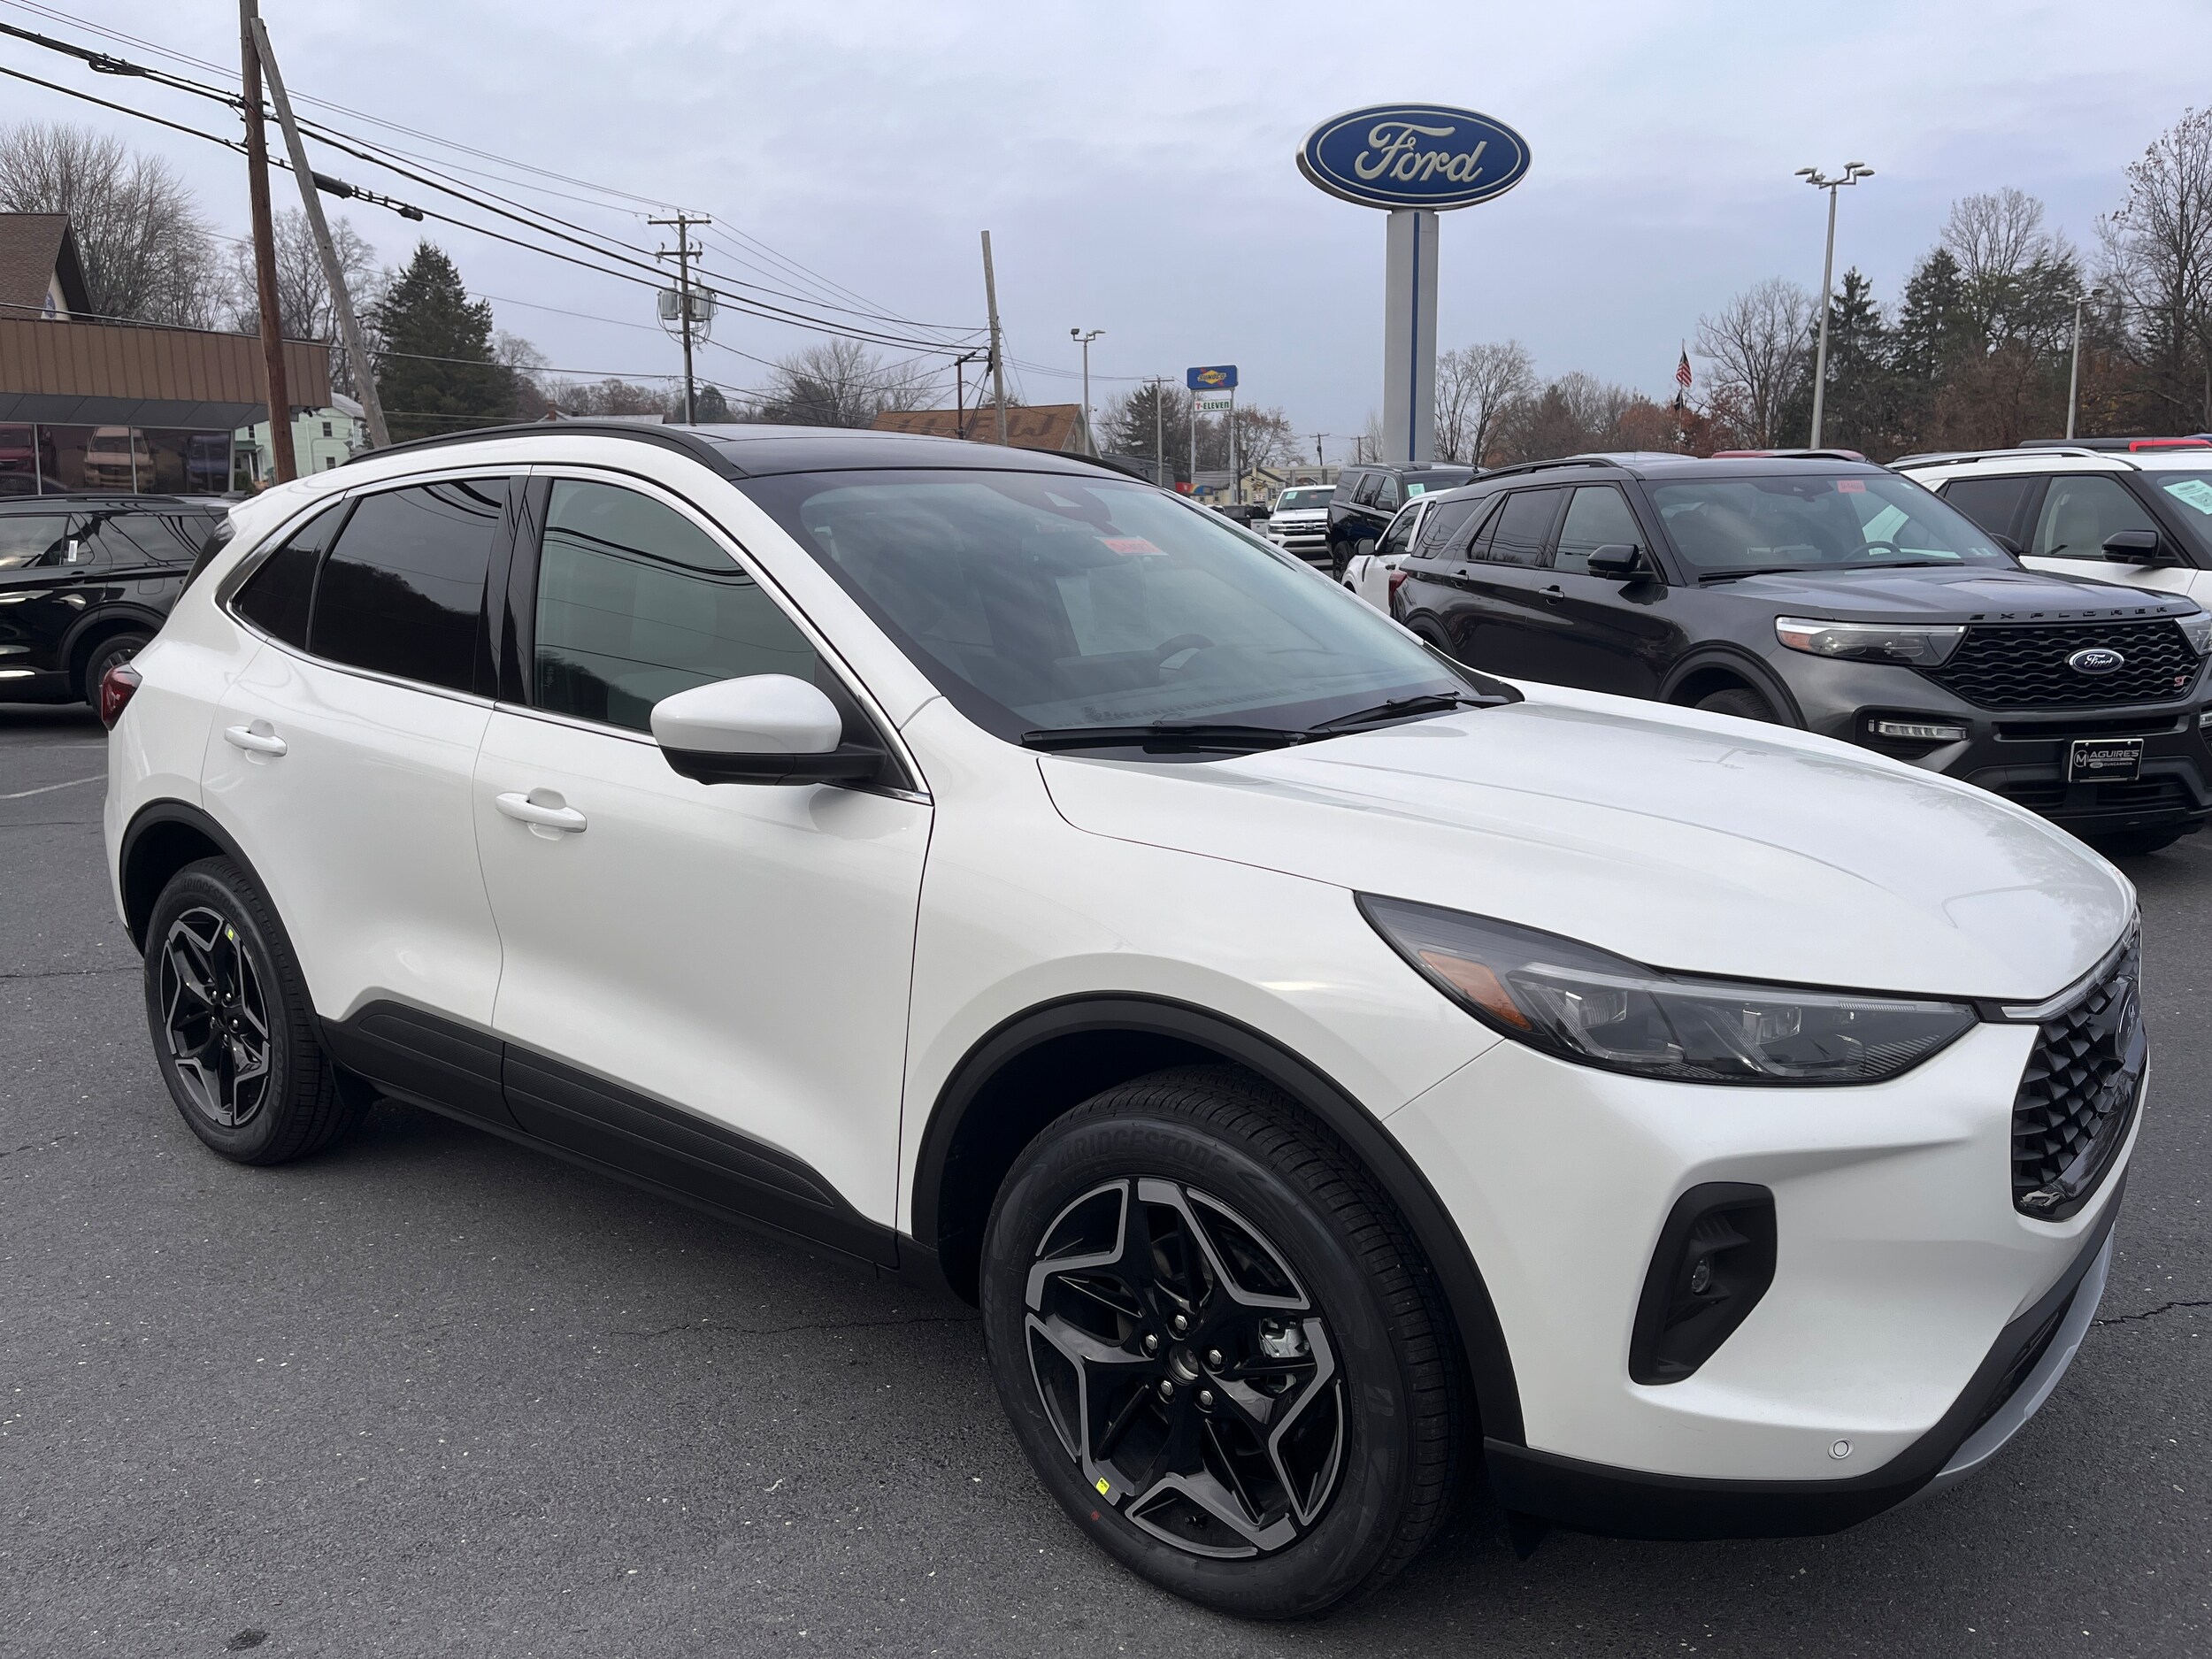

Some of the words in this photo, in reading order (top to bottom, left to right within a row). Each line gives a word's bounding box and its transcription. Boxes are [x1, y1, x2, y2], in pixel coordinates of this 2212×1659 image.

[1355, 121, 1487, 182] Ford
[1197, 373, 1226, 381] SUNOCO
[1969, 606, 2168, 620] EXPLORER
[2084, 654, 2113, 668] Ford
[1056, 1128, 1230, 1171] BRIDGESTONE
